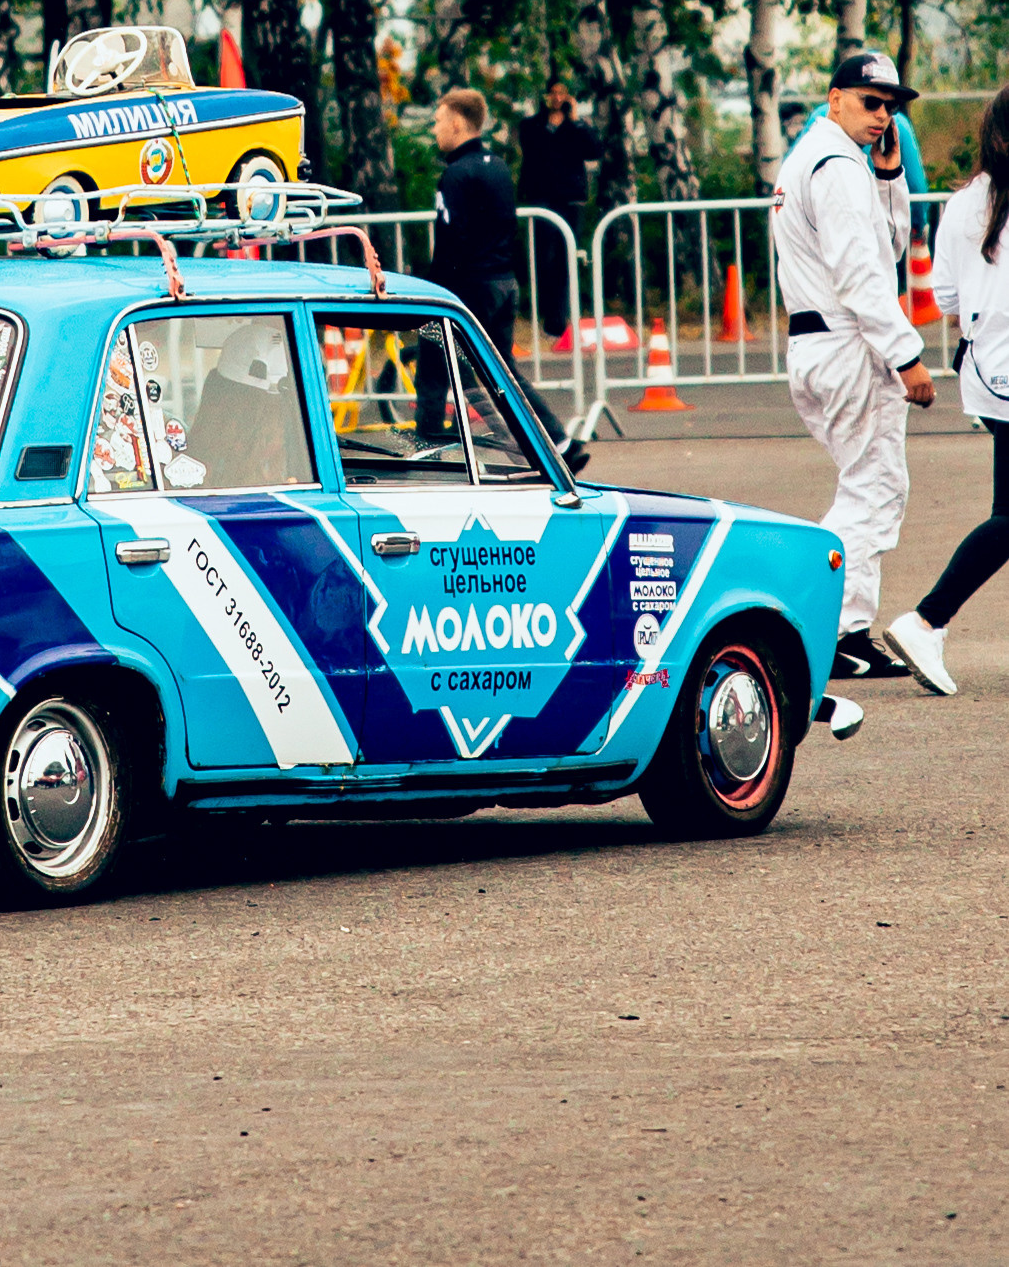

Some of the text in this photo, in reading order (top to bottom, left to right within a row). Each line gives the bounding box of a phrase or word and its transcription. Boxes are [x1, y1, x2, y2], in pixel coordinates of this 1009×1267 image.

[67, 99, 199, 139] МИЛИЦИЯ
[429, 546, 536, 573] сгущенное
[443, 573, 527, 598] цельное
[633, 584, 675, 597] МОЛОКО
[187, 537, 291, 714] ГОСТ 31688-2012
[400, 602, 558, 658] МОЛОКО
[430, 670, 532, 697] с сахаром
